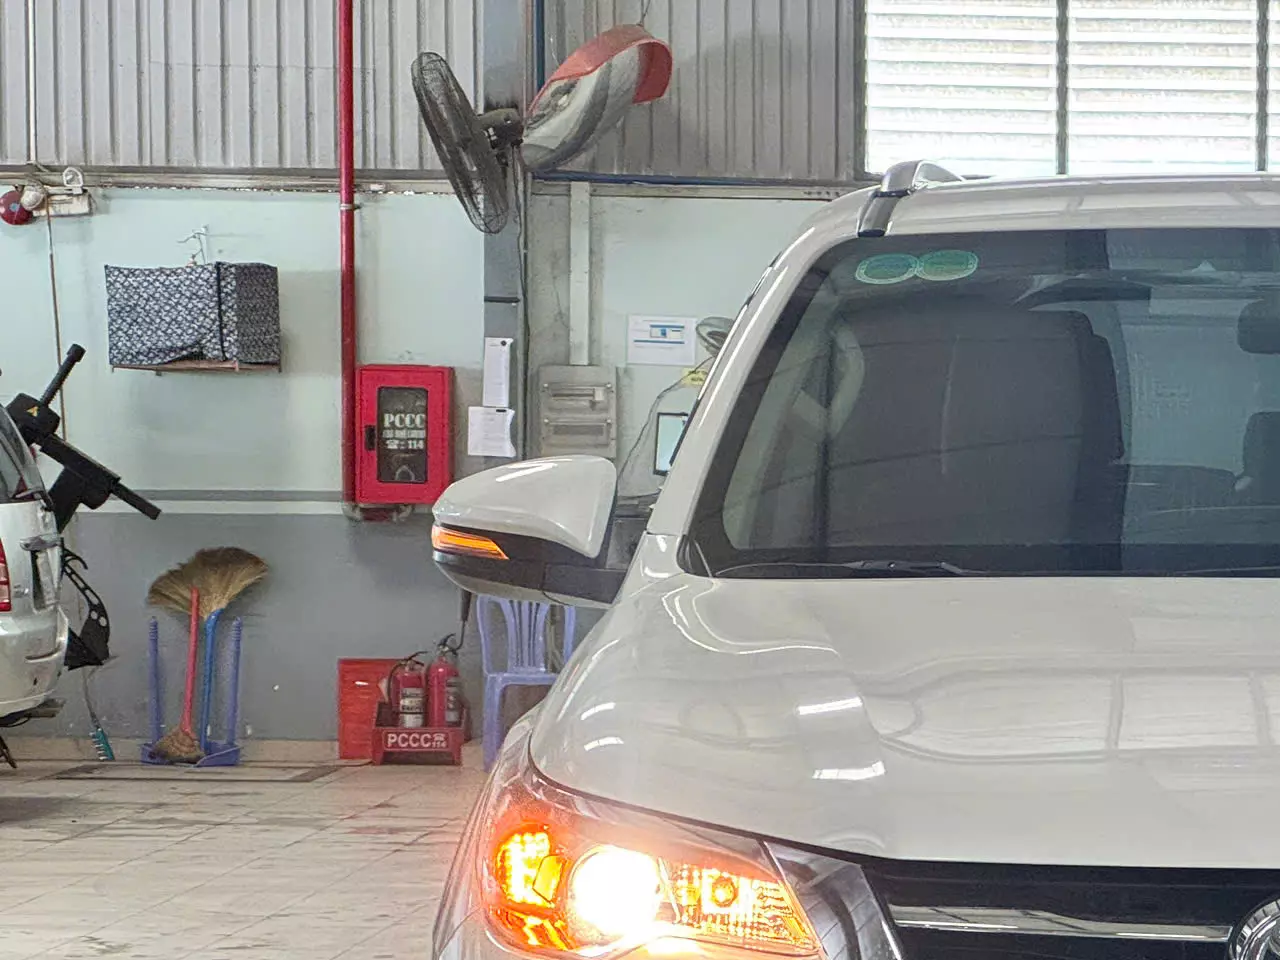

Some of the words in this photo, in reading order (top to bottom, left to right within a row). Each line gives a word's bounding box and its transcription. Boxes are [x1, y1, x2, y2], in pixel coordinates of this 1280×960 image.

[384, 413, 426, 428] PCCC
[408, 440, 424, 449] 114
[387, 733, 432, 748] PCCC
